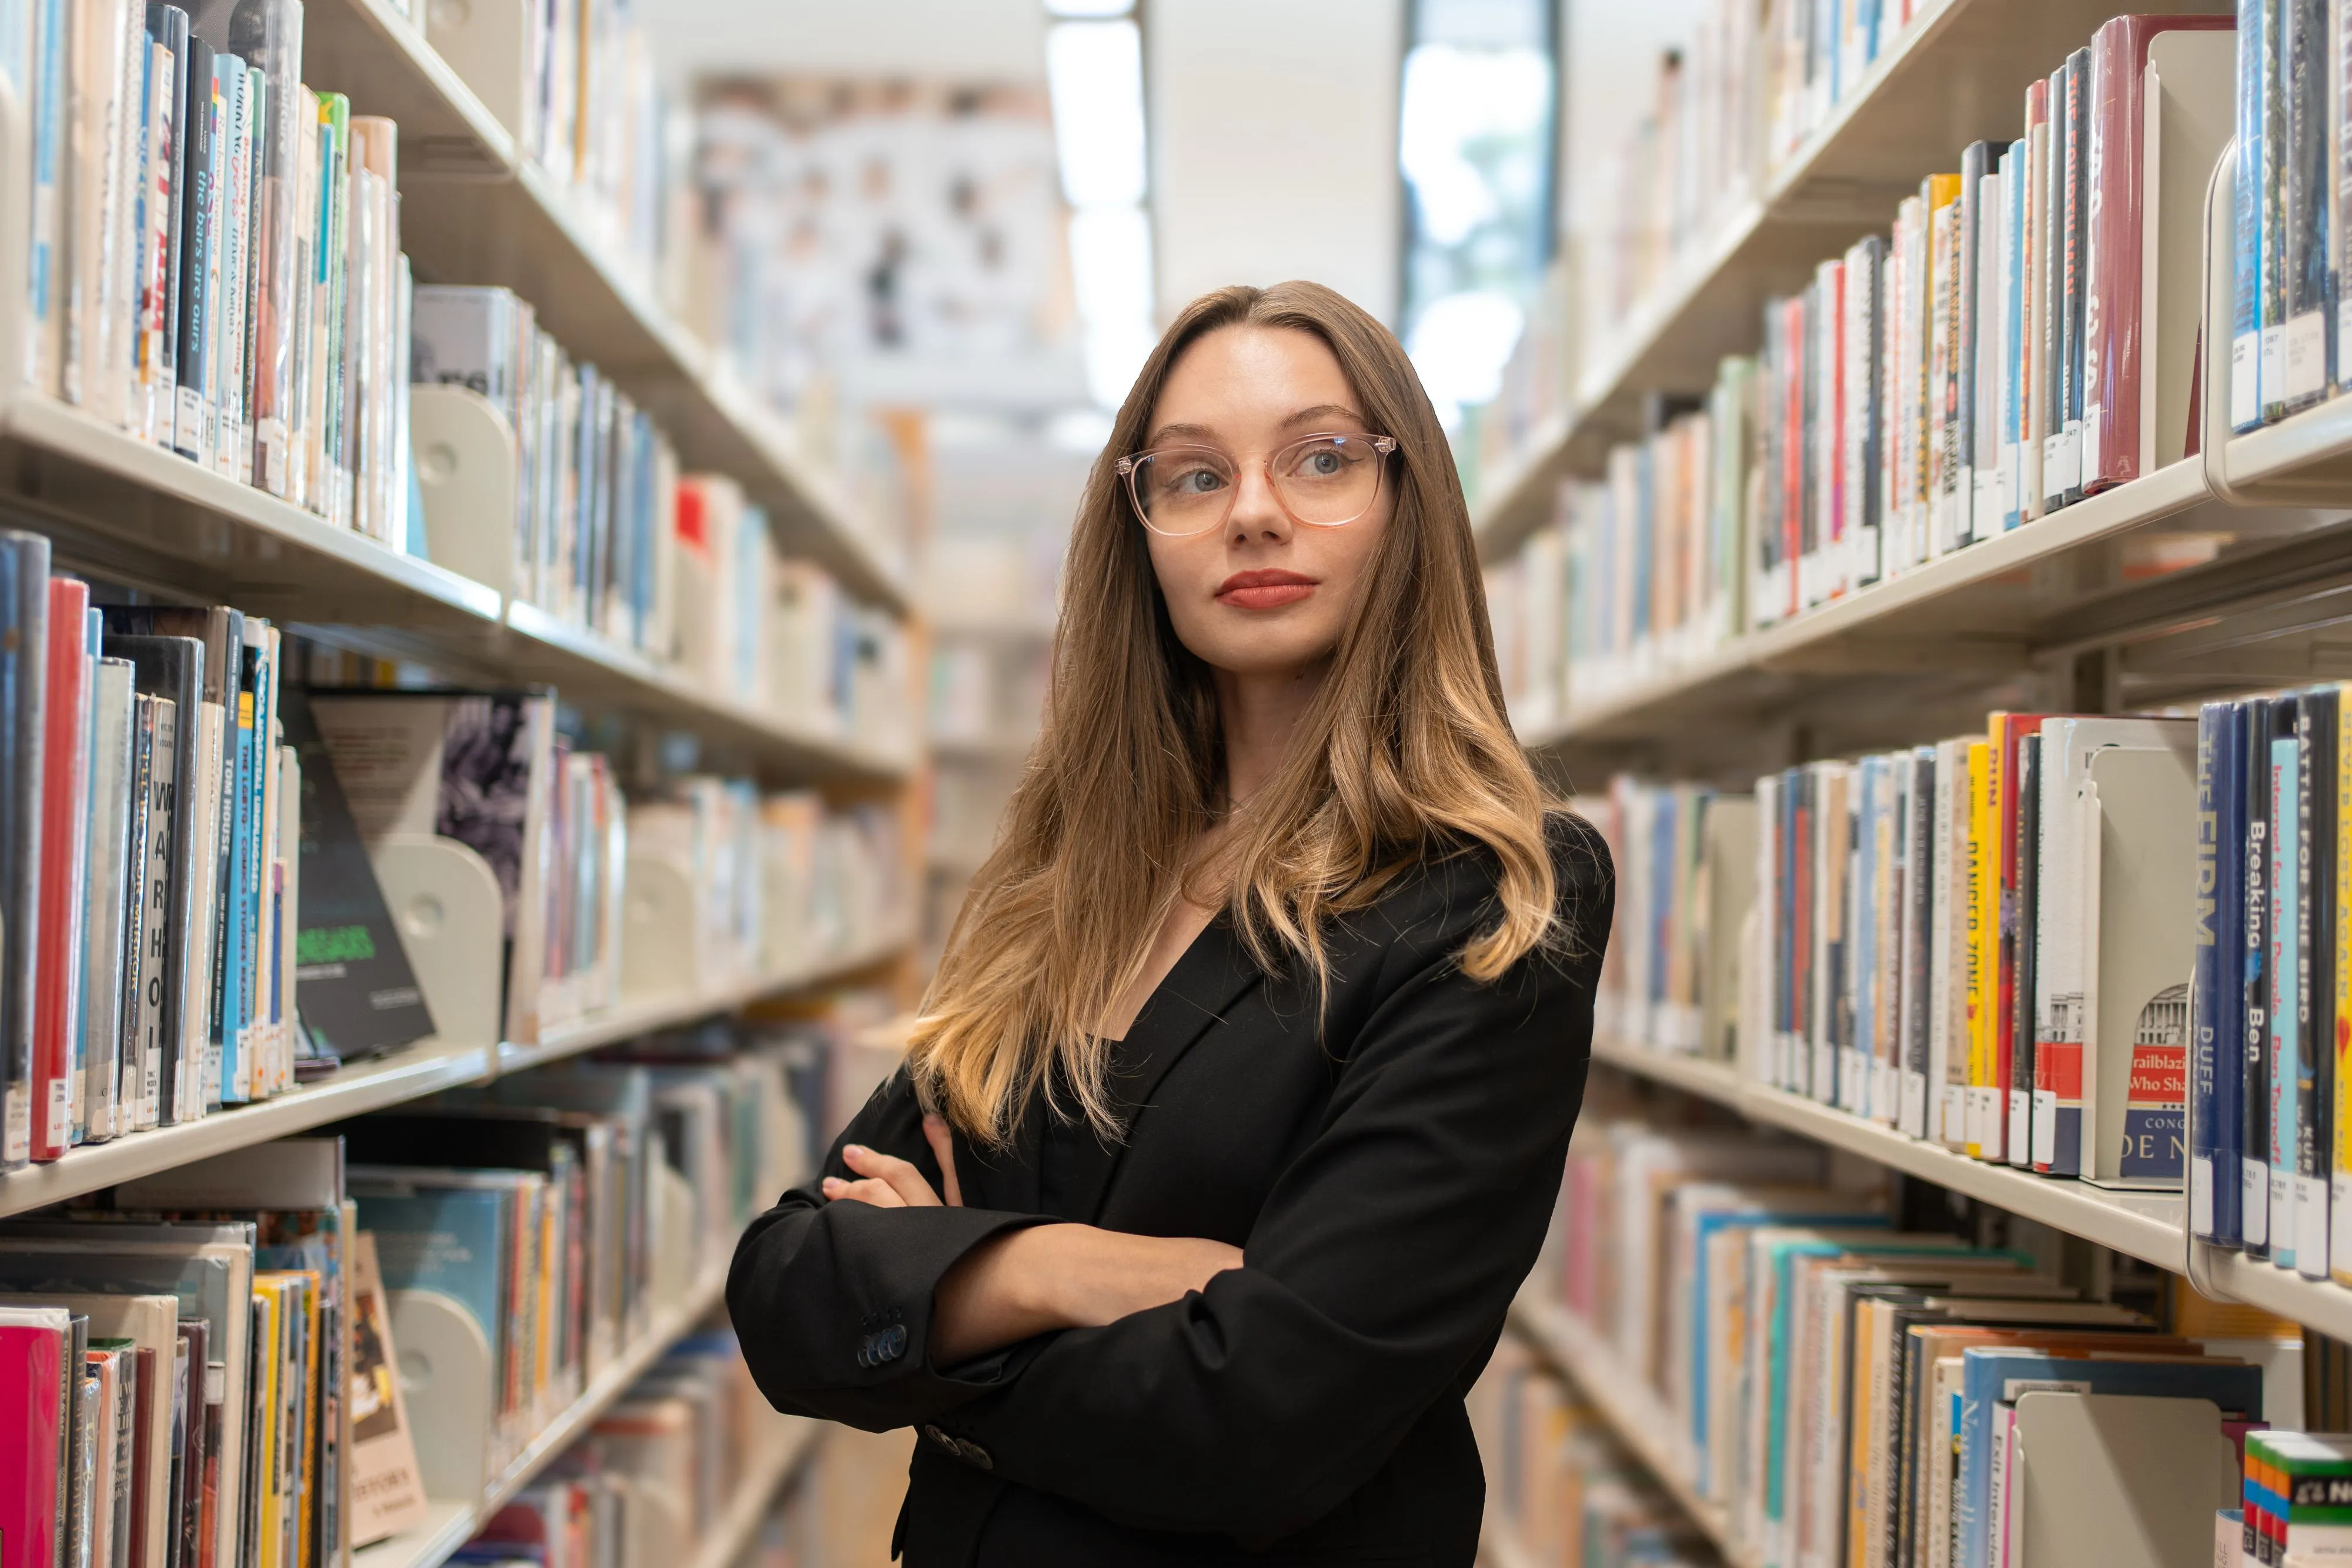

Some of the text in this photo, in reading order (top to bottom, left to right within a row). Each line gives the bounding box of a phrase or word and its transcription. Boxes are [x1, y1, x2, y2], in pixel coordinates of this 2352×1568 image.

[233, 73, 246, 154] WORKING
[2294, 62, 2306, 148] NUTMEG
[211, 114, 225, 255] Rainbow Parenting
[240, 136, 250, 207] Breaking
[2064, 72, 2078, 296] THE FOURTH MAN
[2294, 175, 2303, 242] GILES
[191, 170, 207, 353] the bars are ours
[238, 245, 246, 316] Rainbow
[2261, 198, 2272, 309] FARMS
[234, 320, 242, 376] Ceiling
[221, 757, 234, 857] TOM HOUSE
[2195, 733, 2217, 947] THE FIRM
[2271, 765, 2283, 853] Internet
[2271, 860, 2283, 891] for
[2298, 716, 2311, 1023] BATTLE FOR THE BIRD
[2338, 712, 2351, 998] NEVER LOST AGAIN
[131, 904, 140, 990] MIRROR
[2246, 821, 2267, 1062] Breaking Ben
[2271, 898, 2282, 935] the
[1966, 941, 1979, 996] ZONE
[2270, 941, 2282, 1017] People
[2129, 1076, 2186, 1092] Who Sha
[2133, 1054, 2186, 1070] railblazi
[2199, 1025, 2214, 1095] DUFF
[2270, 1035, 2281, 1079] Ben
[2145, 1118, 2186, 1129] CONG
[2169, 1135, 2185, 1159] N
[2270, 1082, 2281, 1166] Tarnoff
[2303, 1126, 2313, 1174] KUR
[1990, 1481, 2002, 1568] Intervie
